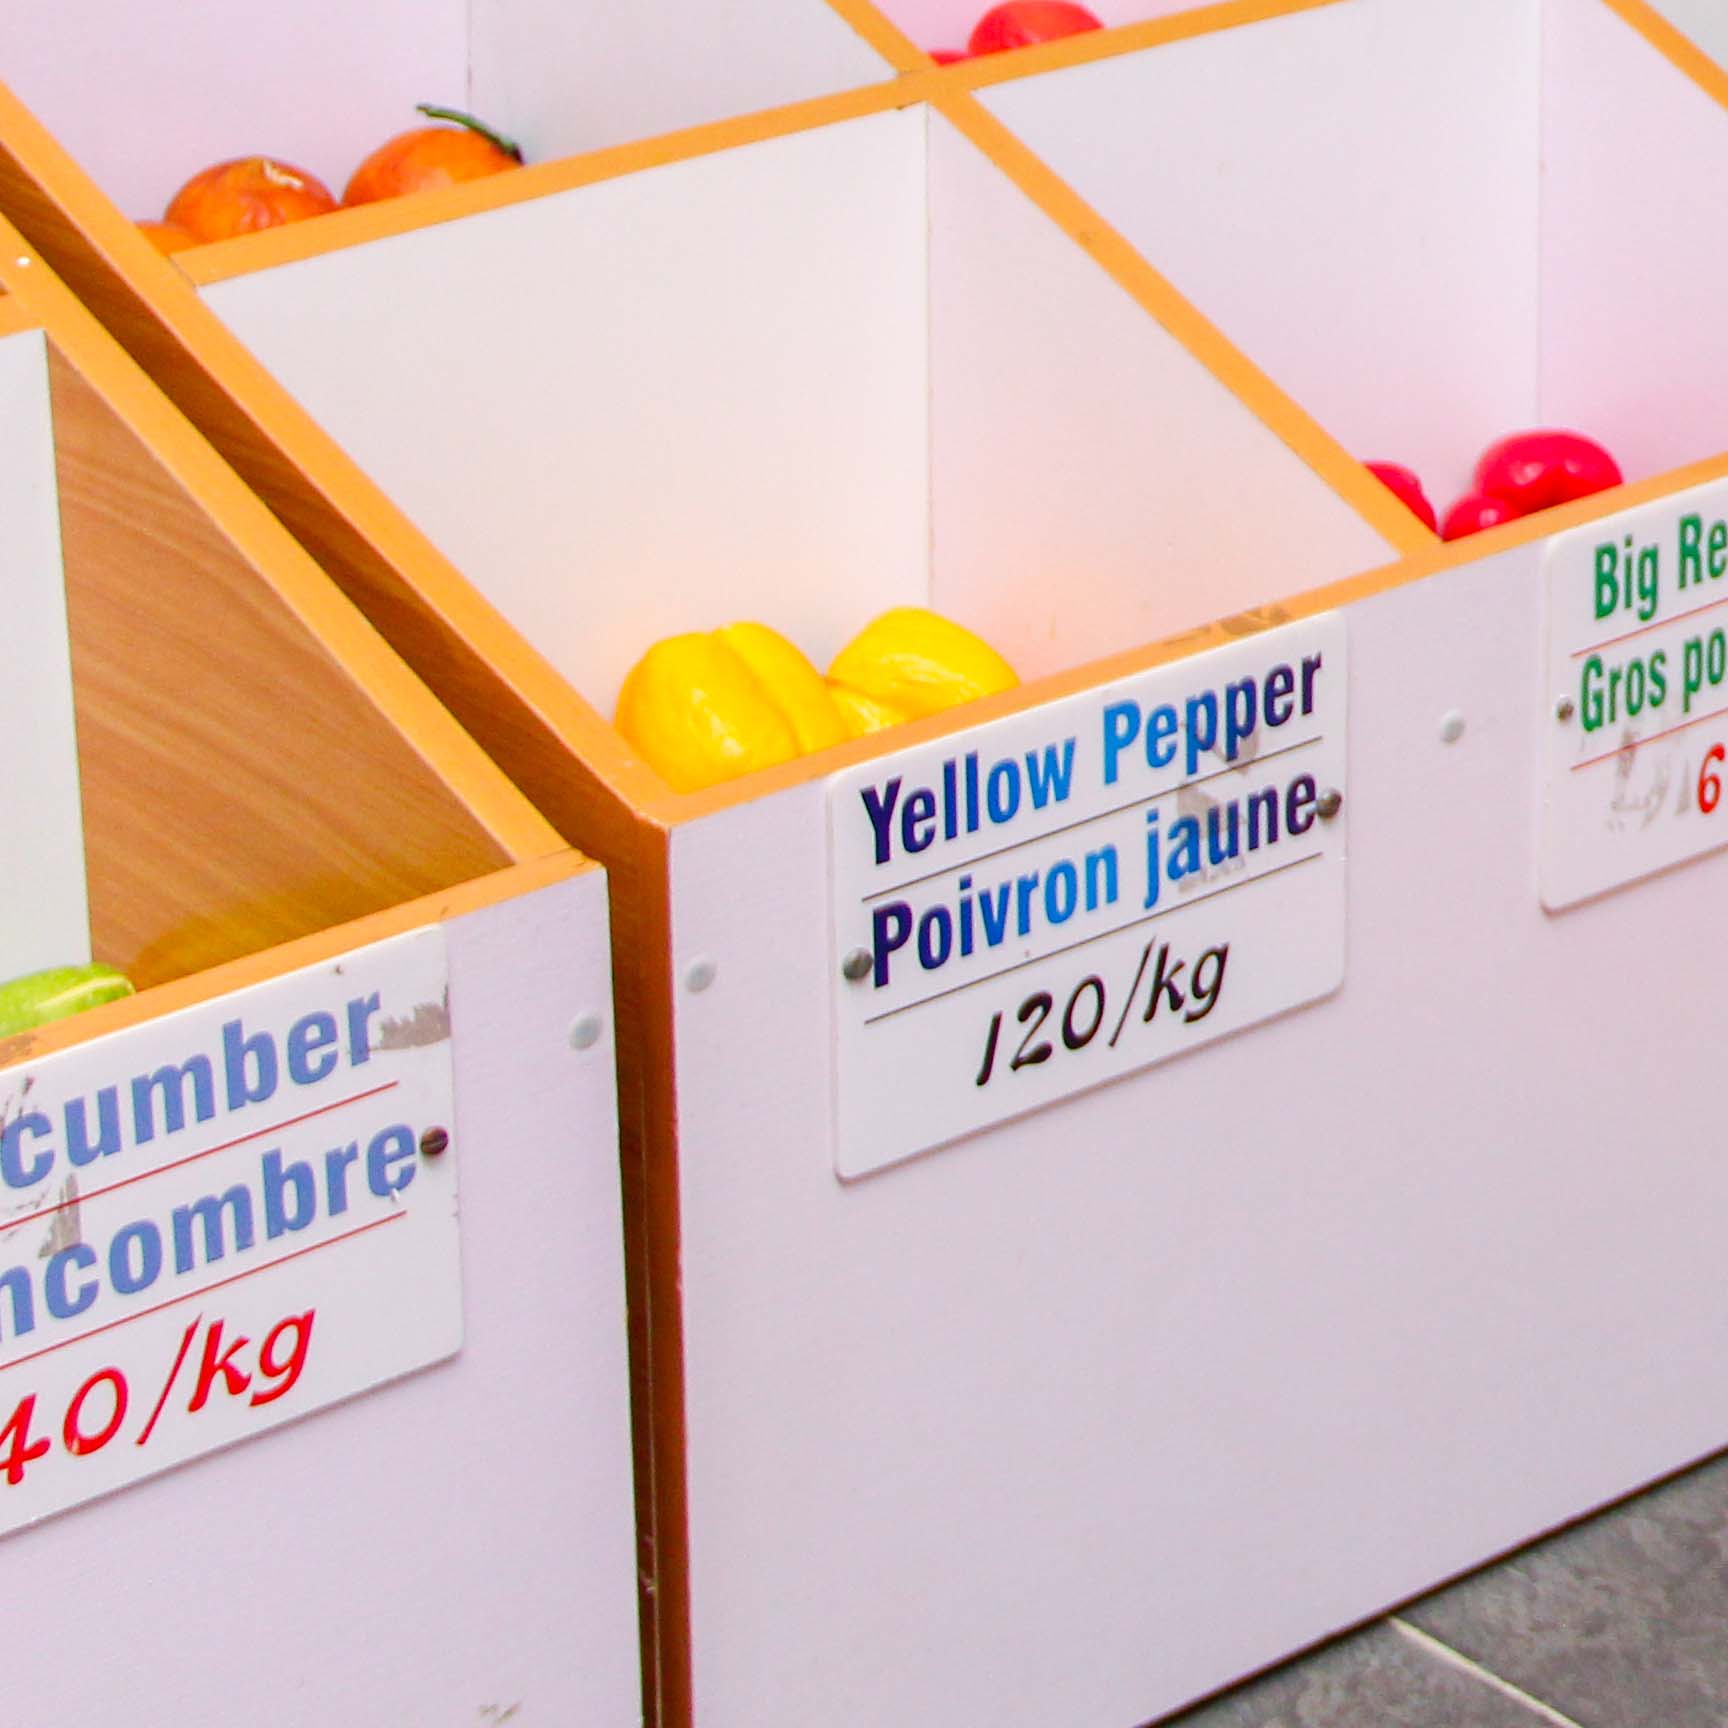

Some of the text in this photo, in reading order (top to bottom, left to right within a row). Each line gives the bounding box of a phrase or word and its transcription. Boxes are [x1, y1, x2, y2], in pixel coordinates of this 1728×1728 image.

[1594, 535, 1660, 622] Big
[860, 652, 1323, 866] Yellow Pepper
[1579, 649, 1668, 734] Gros
[871, 772, 1319, 989] Poivron jaune
[976, 935, 1231, 1087] 120/kg
